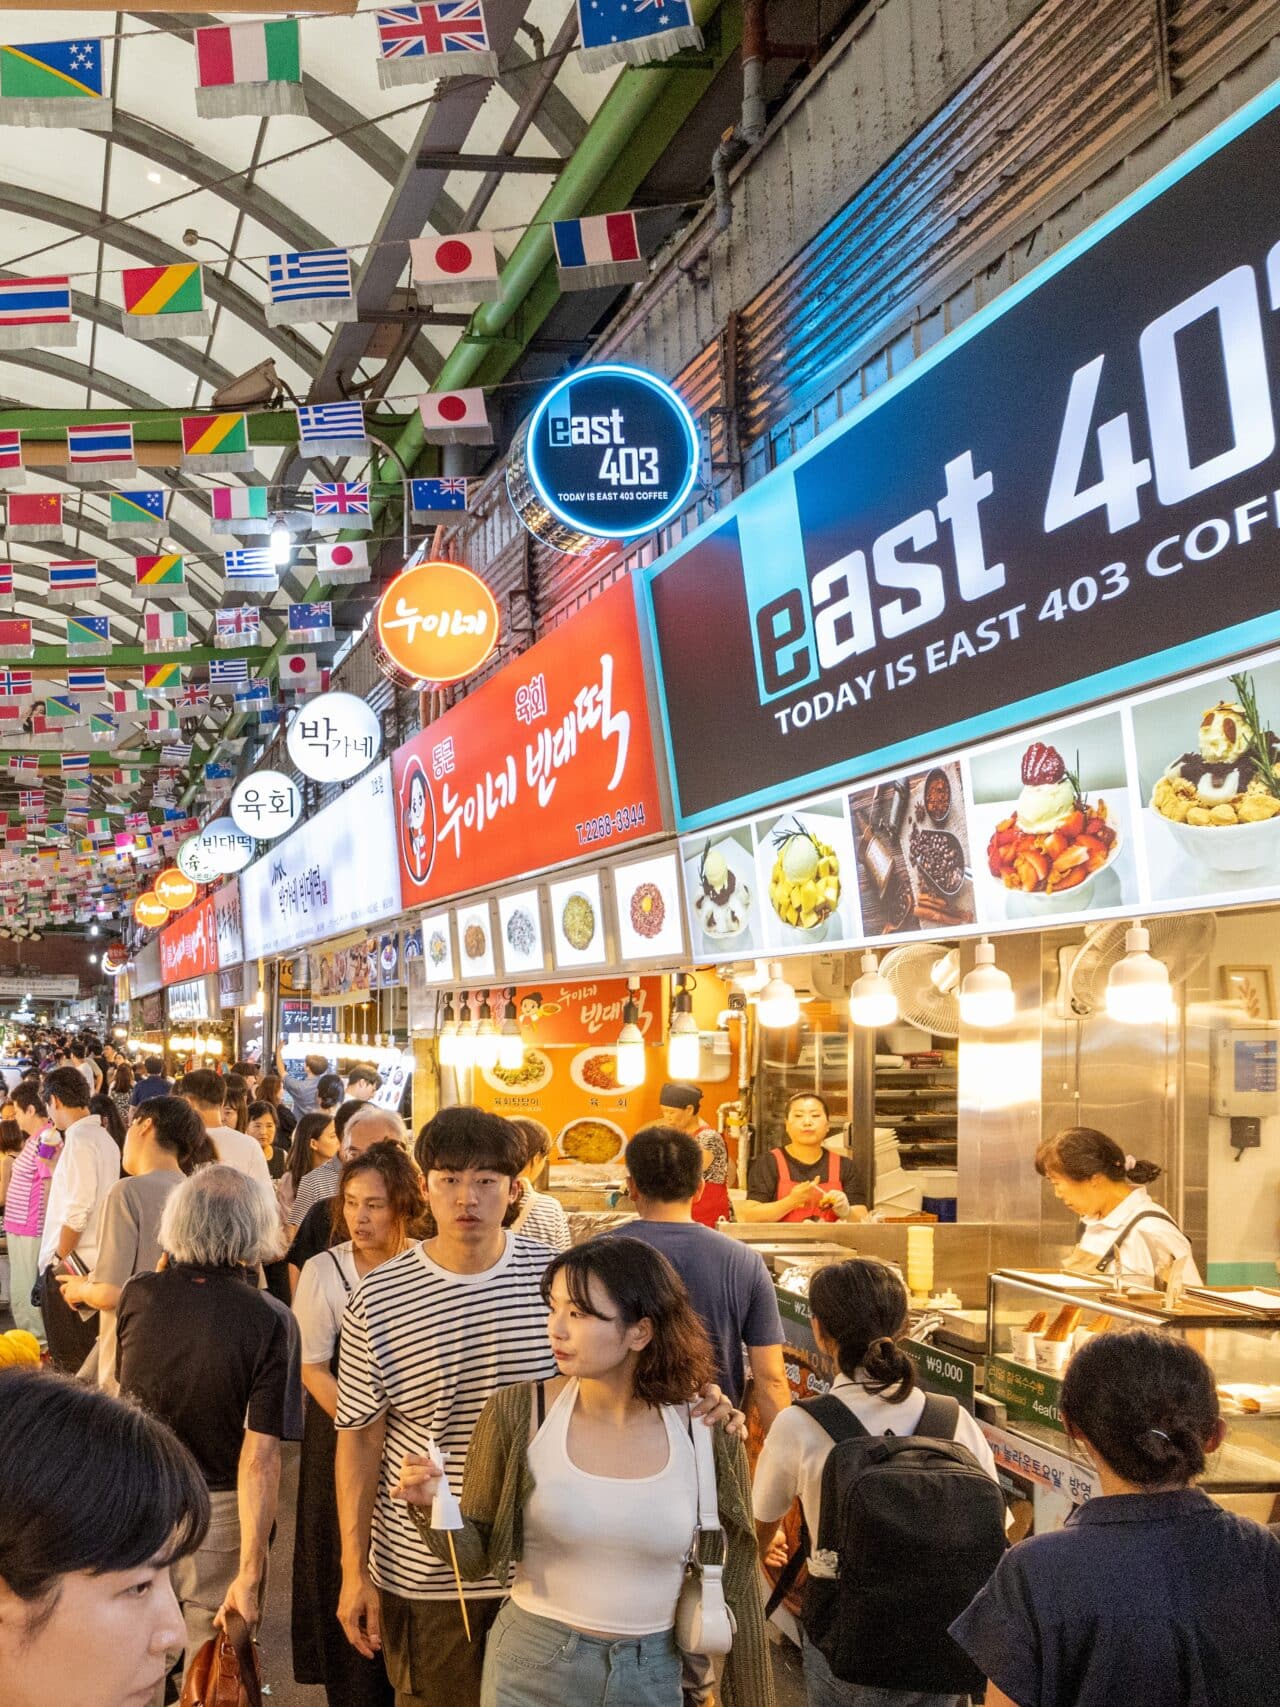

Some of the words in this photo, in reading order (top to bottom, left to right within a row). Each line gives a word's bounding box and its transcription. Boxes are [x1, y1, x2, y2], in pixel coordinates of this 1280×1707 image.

[550, 408, 625, 446] east
[599, 447, 660, 486] 403
[756, 450, 1006, 697] east
[1043, 238, 1280, 535] 40
[558, 493, 585, 502] TODAY
[587, 493, 595, 501] IS
[596, 492, 618, 501] EAST
[619, 492, 634, 501] 403
[636, 491, 668, 501] COFFEE
[384, 598, 488, 644] 누이네
[775, 670, 876, 735] TODAY
[886, 654, 916, 690] IS
[927, 604, 1026, 675] EAST
[1038, 562, 1130, 623] 403
[1145, 488, 1280, 577] COF
[515, 673, 548, 724] 육회
[300, 717, 373, 759] 박가네
[437, 756, 520, 859] 누이네
[526, 654, 631, 808] 빈대떡
[238, 787, 295, 821] 육회
[576, 803, 646, 846] T.2268-3344
[203, 835, 252, 854] 빈대떡
[926, 1355, 963, 1383] ₩9,000
